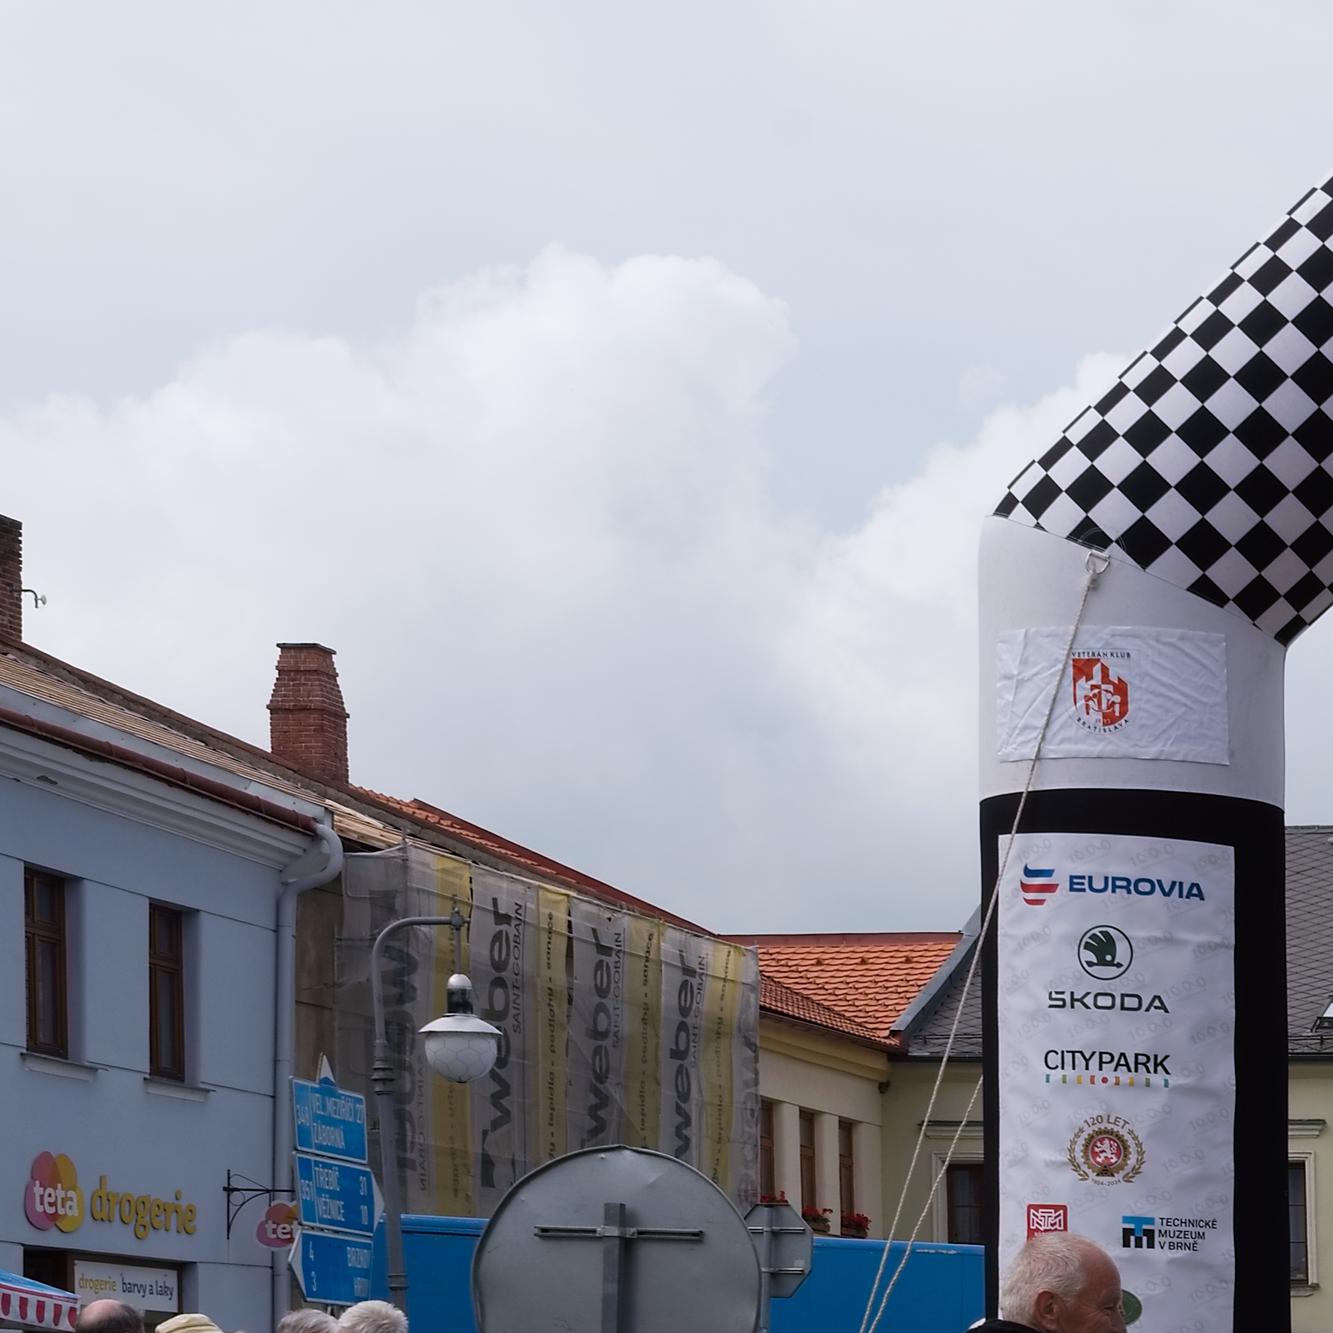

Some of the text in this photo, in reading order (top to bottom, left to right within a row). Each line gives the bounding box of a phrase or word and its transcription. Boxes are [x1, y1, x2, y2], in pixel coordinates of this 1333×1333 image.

[1068, 875, 1205, 901] EUROVIA
[512, 902, 523, 1034] SAINT-GOBAIN
[481, 897, 514, 1133] weber
[584, 927, 614, 1141] weber
[669, 949, 698, 1159] weber
[1043, 1049, 1171, 1076] CITYPARK
[1083, 1114, 1130, 1129] 120 LET
[34, 1174, 198, 1240] teta drogerie
[265, 1220, 300, 1240] tet
[1158, 1229, 1206, 1241] MUZEUM
[1159, 1217, 1218, 1230] TECHNICKÉ
[1158, 1239, 1199, 1252] V BRNĚ
[79, 1274, 174, 1300] drogerie barvy a laky
